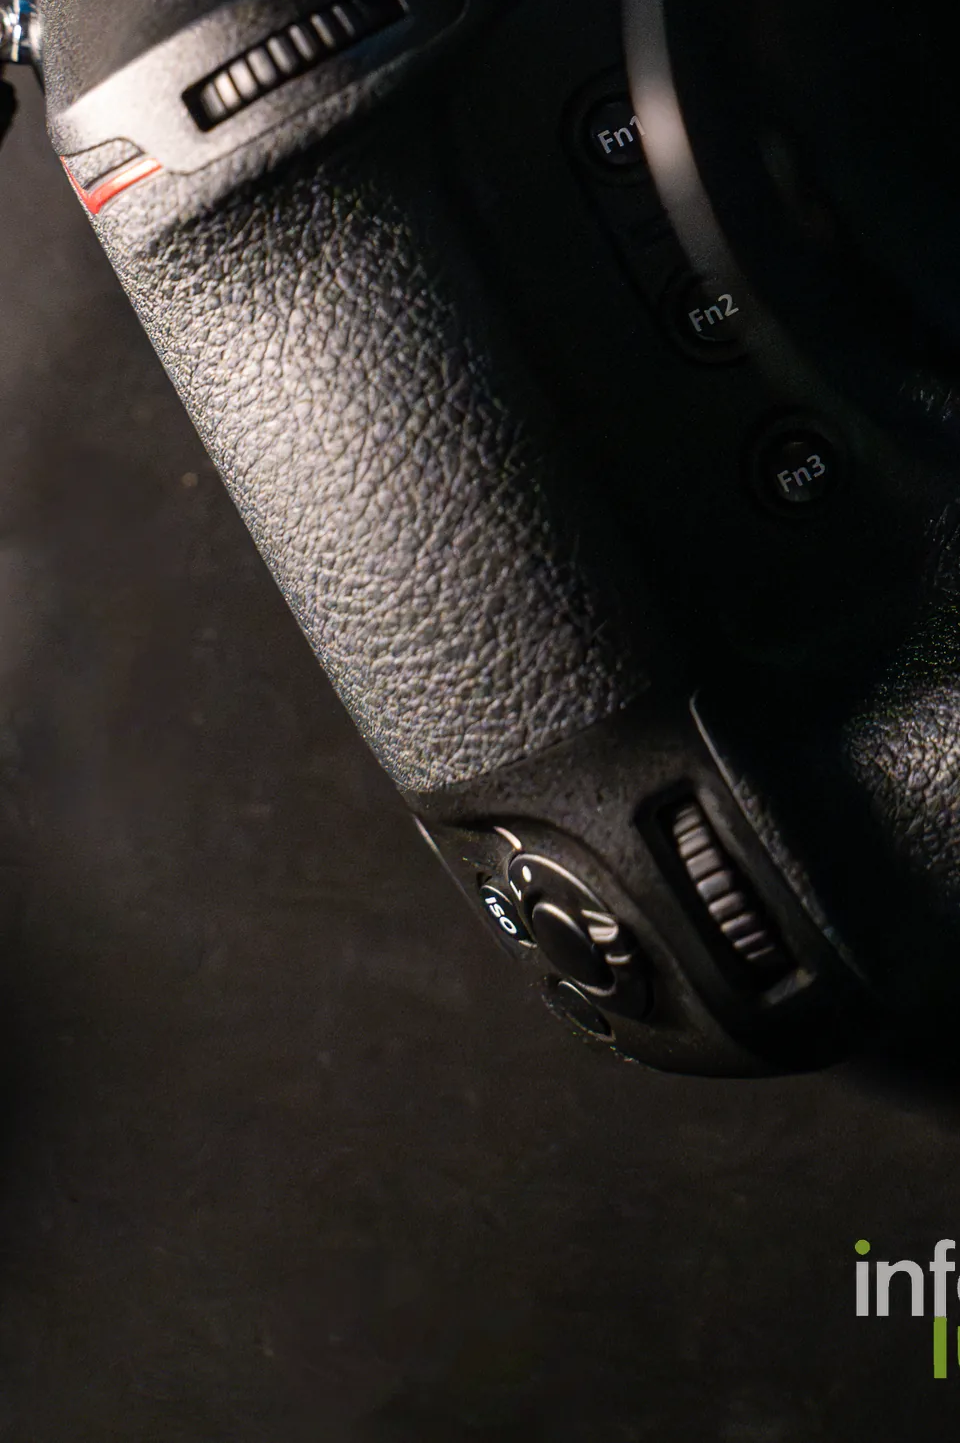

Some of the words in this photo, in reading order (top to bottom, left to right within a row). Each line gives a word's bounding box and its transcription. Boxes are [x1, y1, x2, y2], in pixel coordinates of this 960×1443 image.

[597, 115, 646, 154] Fn1
[688, 293, 740, 332] Fn2
[776, 453, 826, 493] Fn3
[484, 896, 518, 935] ISO
